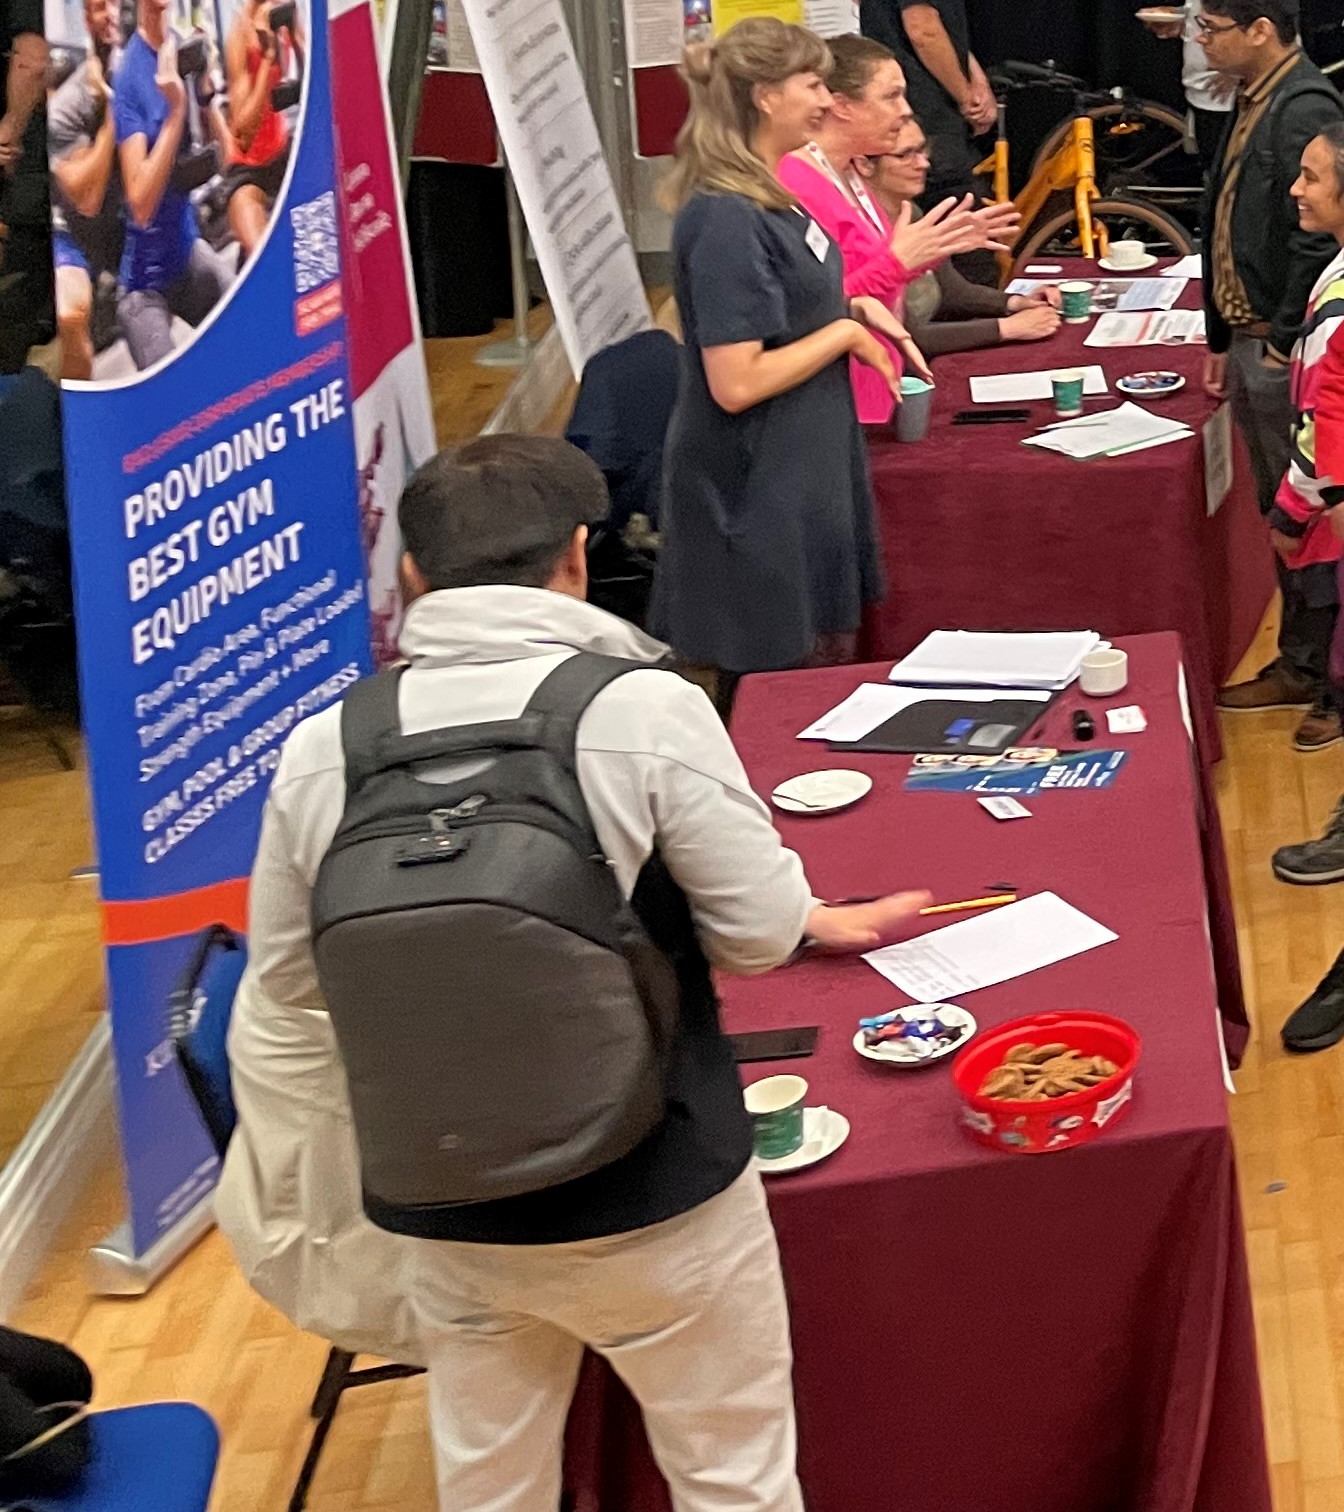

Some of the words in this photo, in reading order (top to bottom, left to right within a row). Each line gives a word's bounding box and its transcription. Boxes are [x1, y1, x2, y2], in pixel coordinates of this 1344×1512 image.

[124, 412, 287, 539] PROVIDING
[288, 377, 346, 439] THE
[128, 519, 203, 603] BEST
[207, 477, 275, 548] GYM
[131, 520, 305, 665] EQUIPMENT
